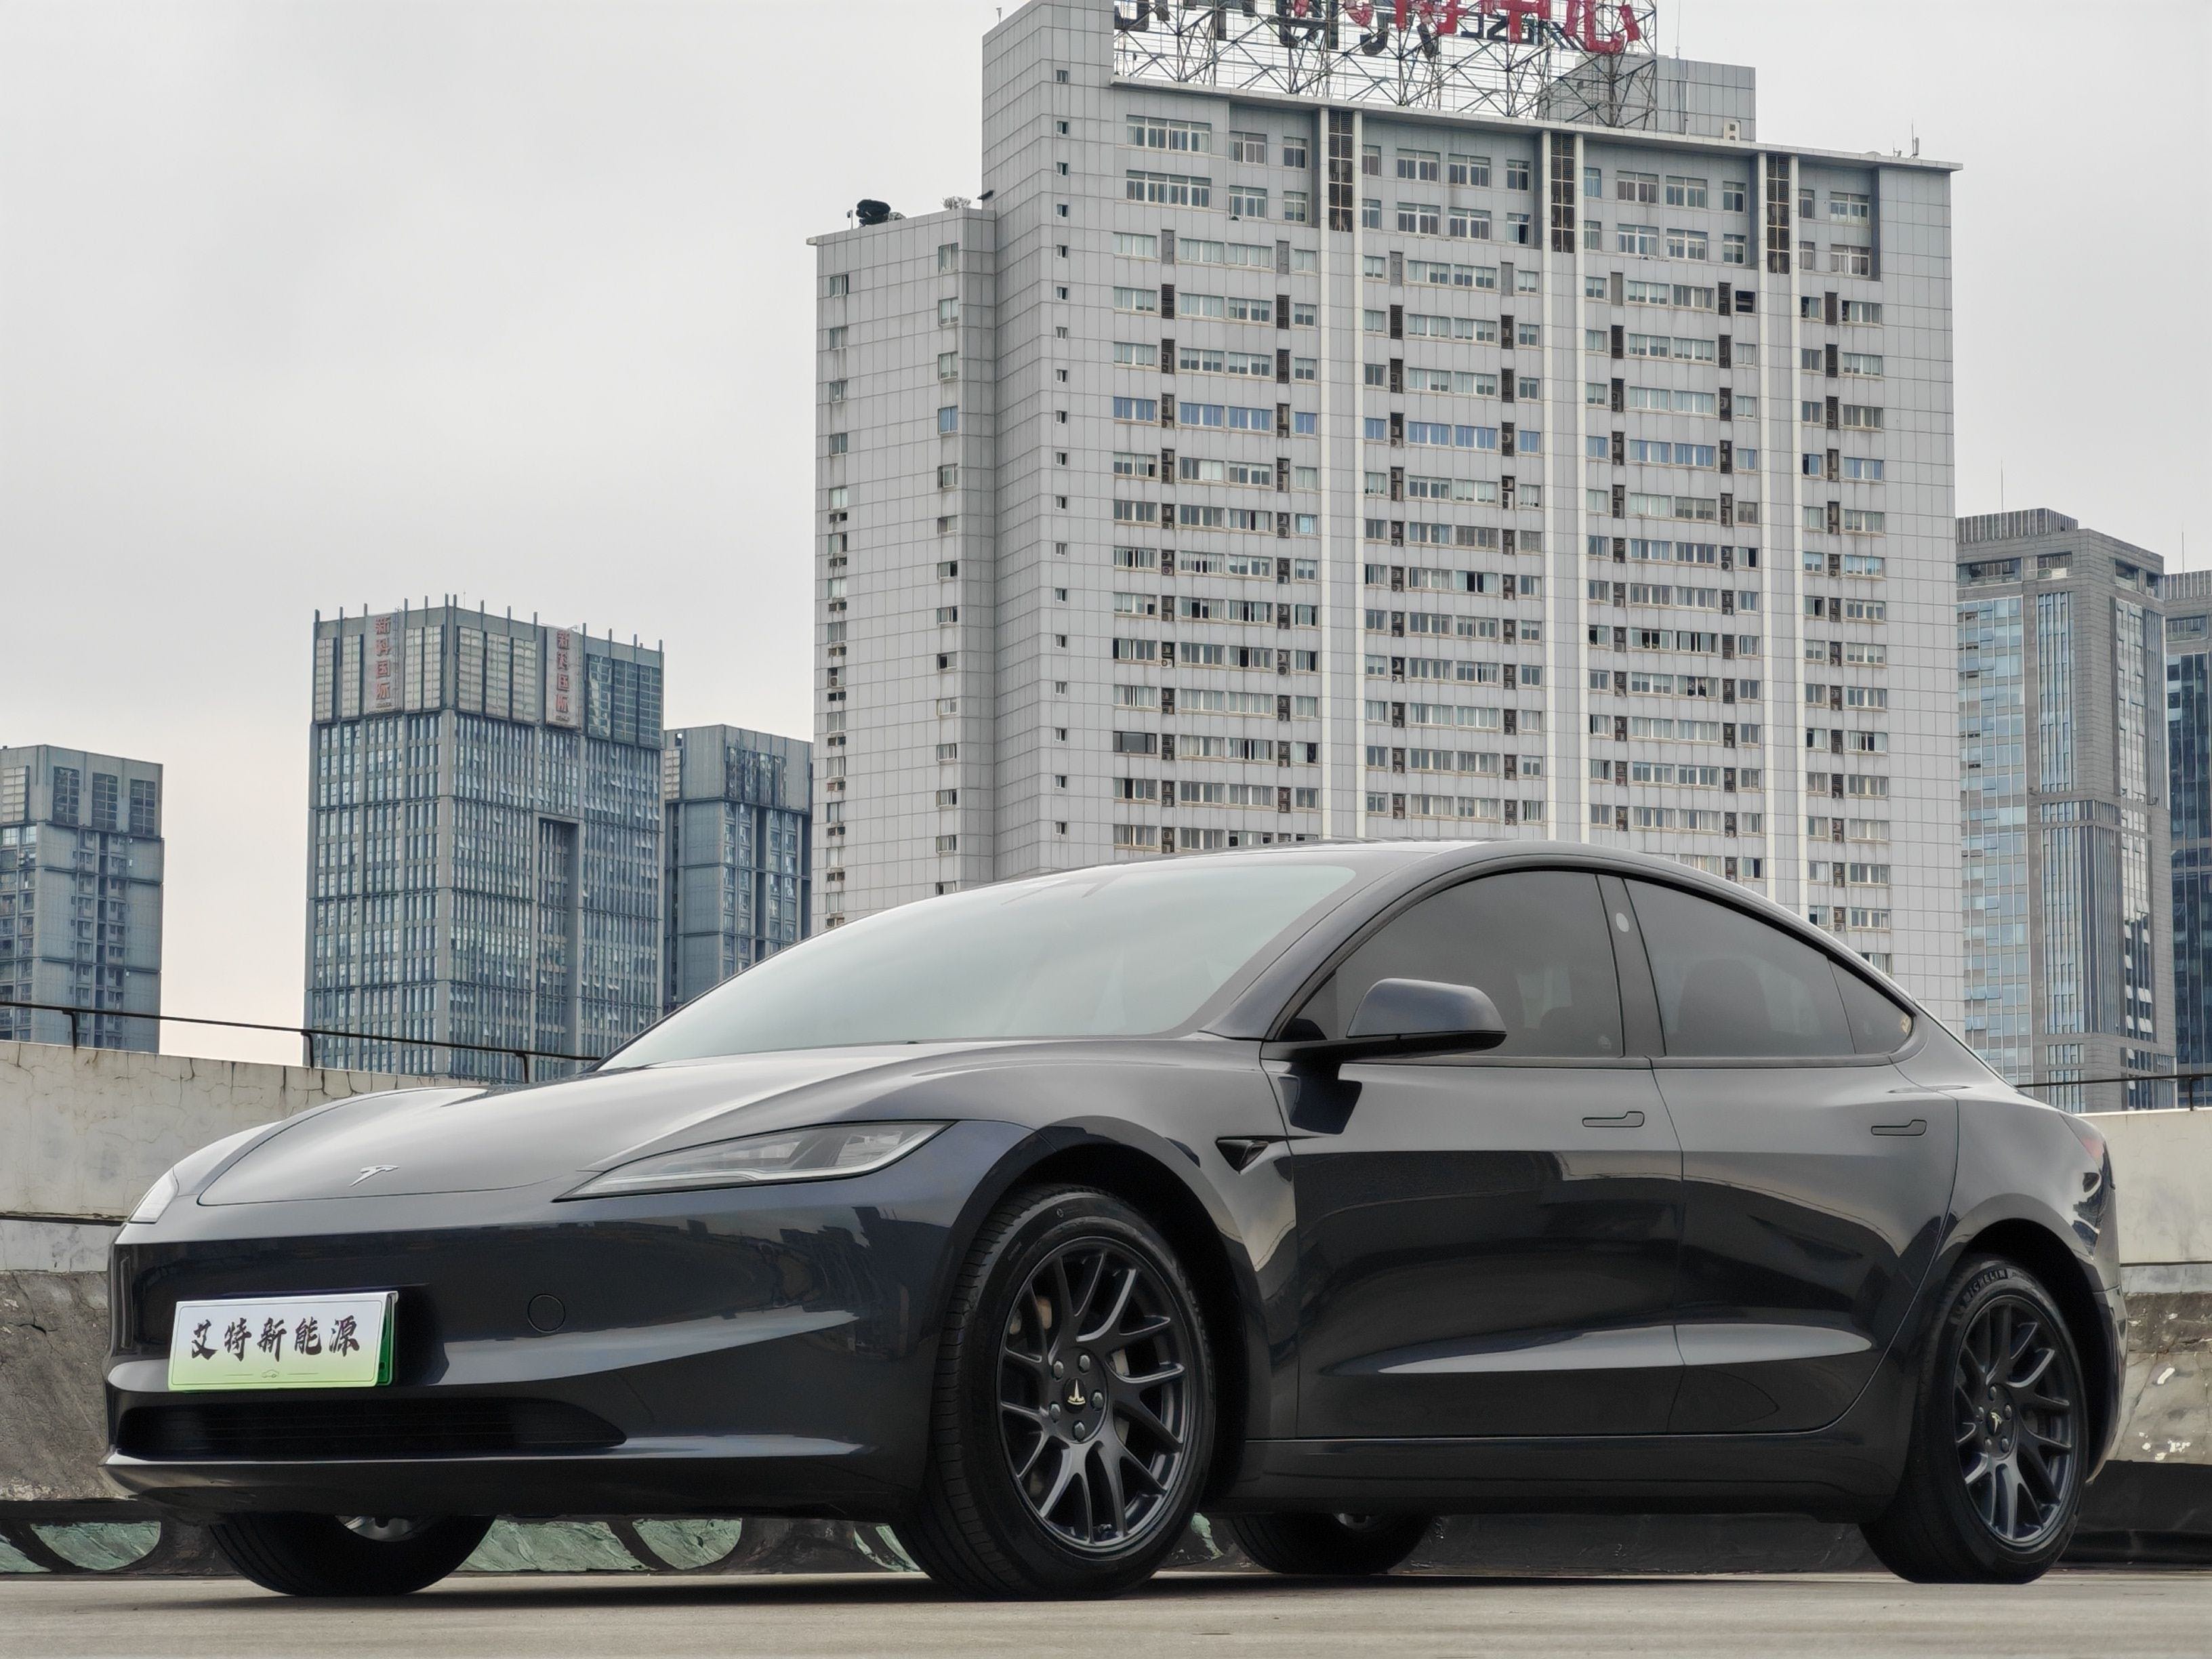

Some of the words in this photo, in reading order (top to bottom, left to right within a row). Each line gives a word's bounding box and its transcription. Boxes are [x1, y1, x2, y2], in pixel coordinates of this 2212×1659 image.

[191, 1315, 360, 1361] 艾特新能源
